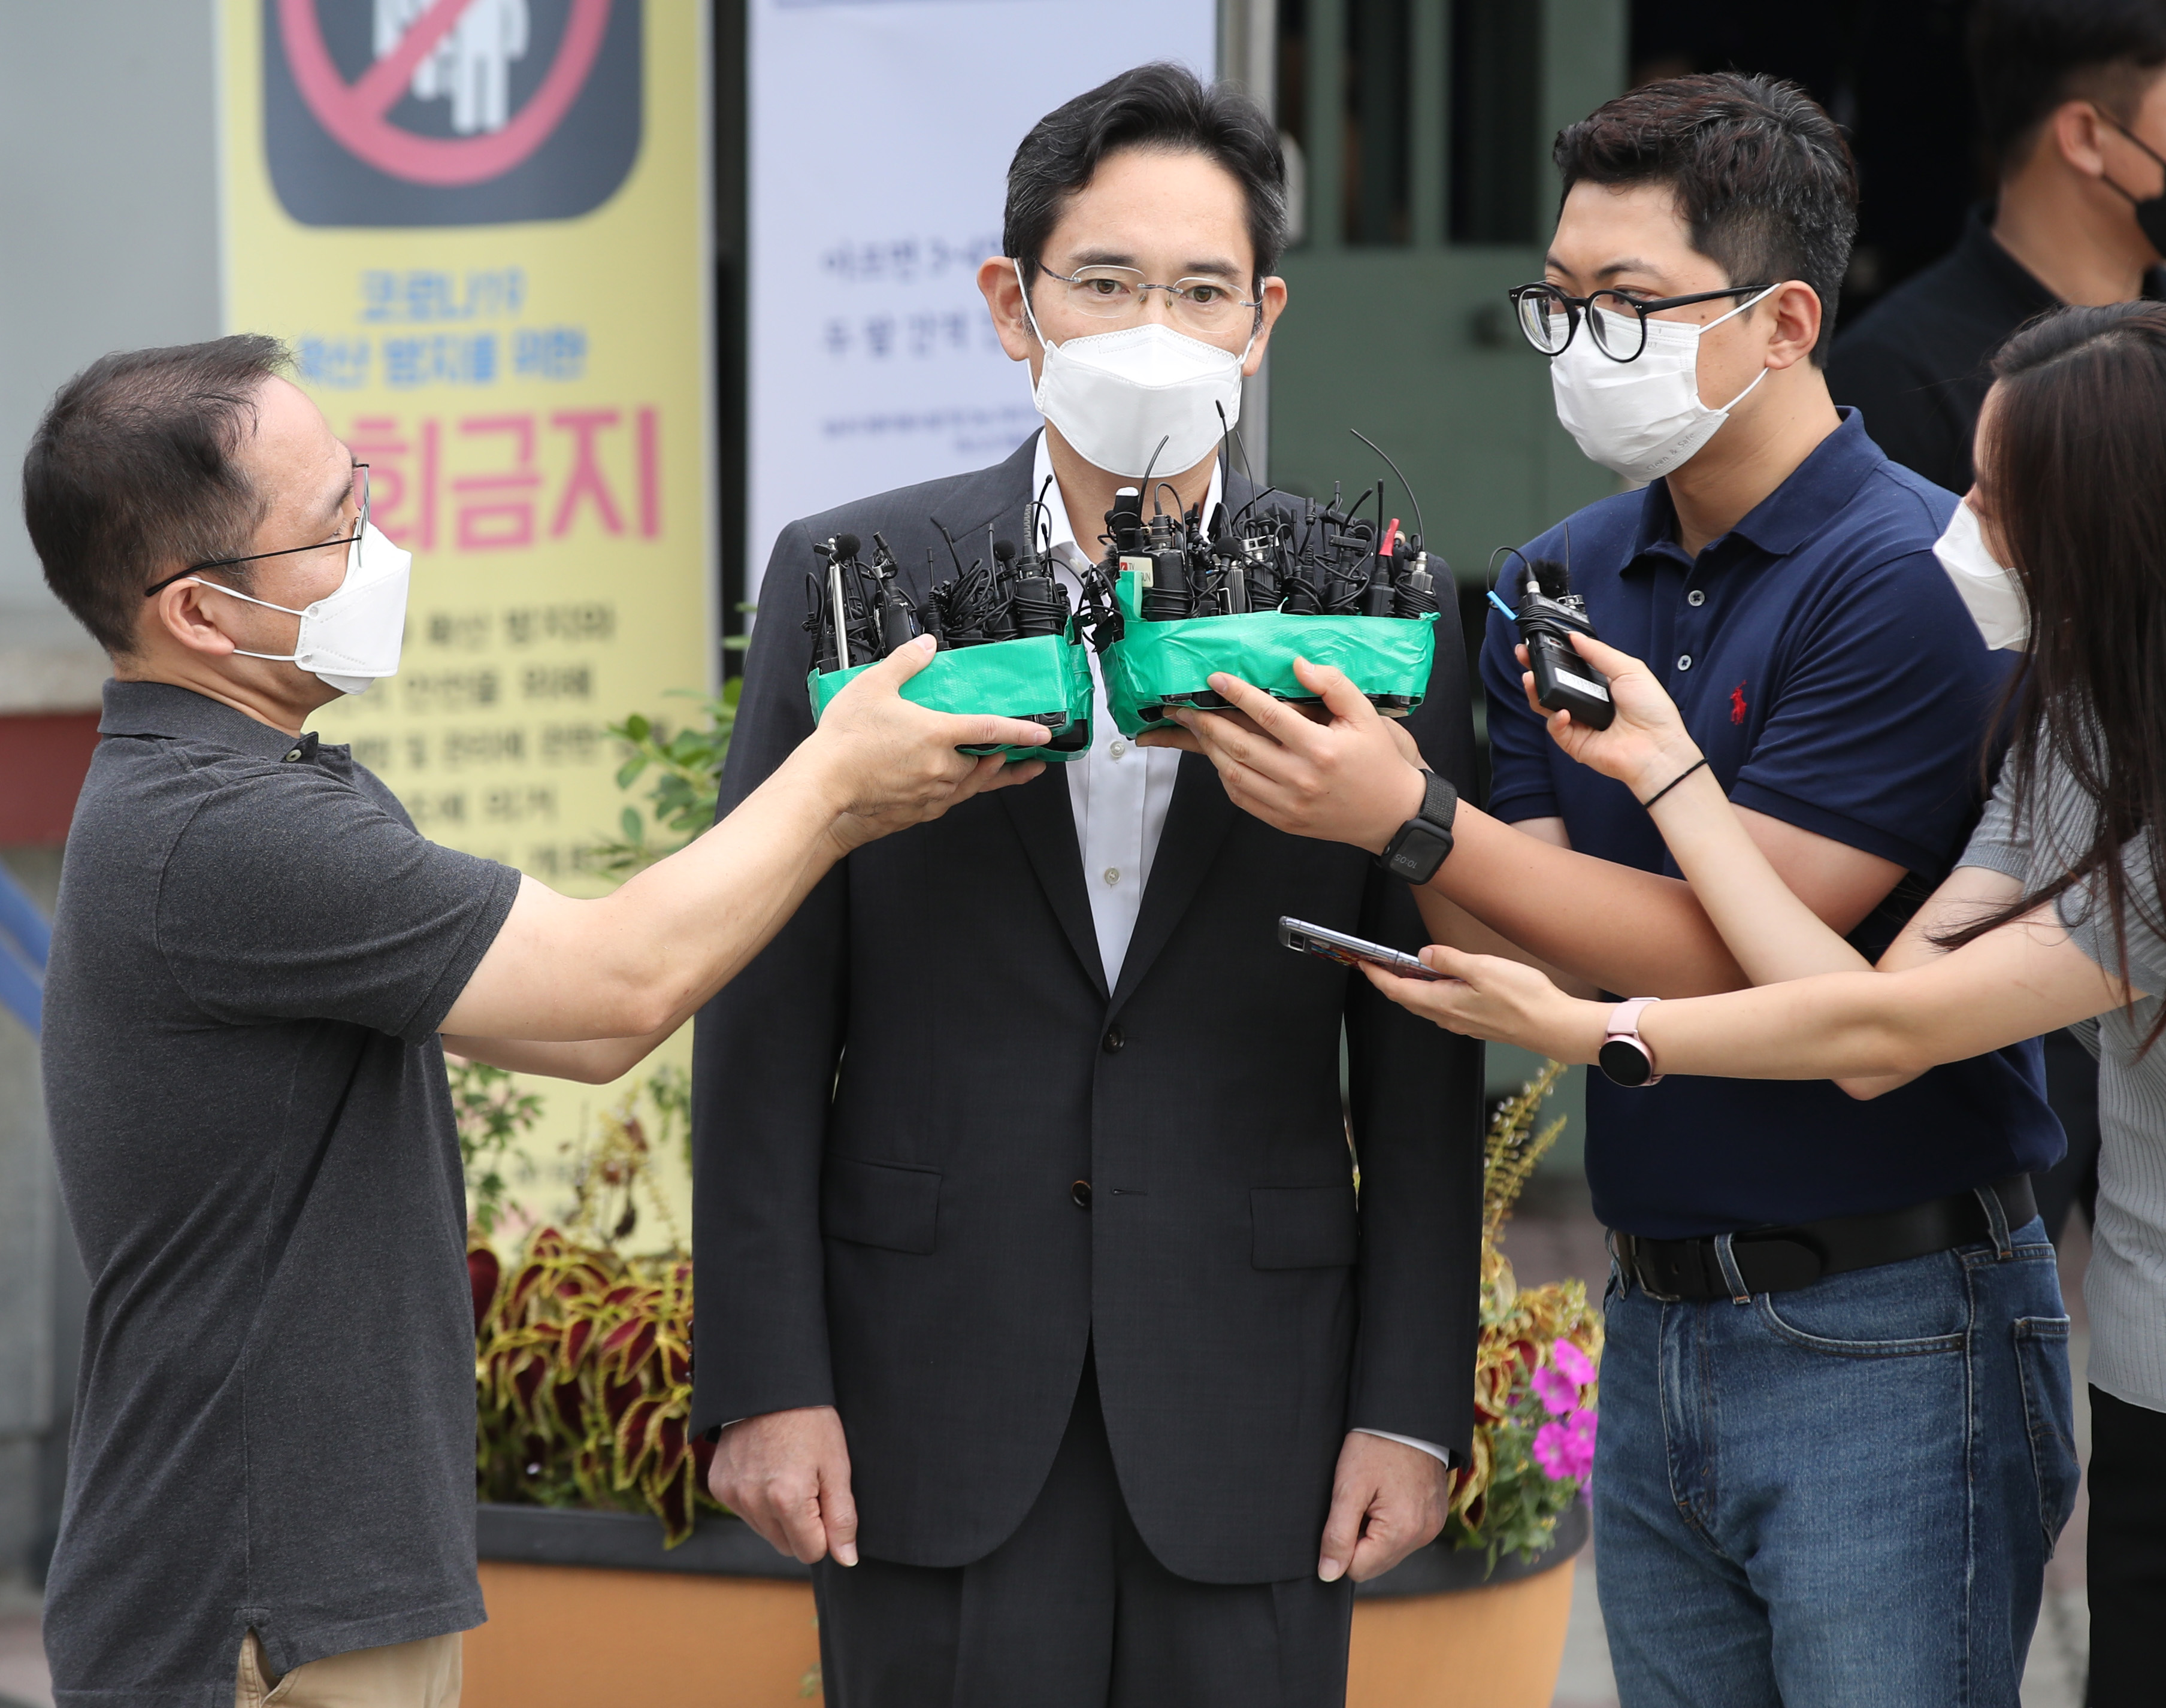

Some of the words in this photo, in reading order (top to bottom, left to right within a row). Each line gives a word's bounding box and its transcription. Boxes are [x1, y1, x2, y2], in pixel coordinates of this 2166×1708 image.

[1647, 456, 1669, 471] Clean
[1678, 433, 1695, 448] Safe
[349, 407, 662, 552] 회금지
[1394, 854, 1418, 869] 10:05
